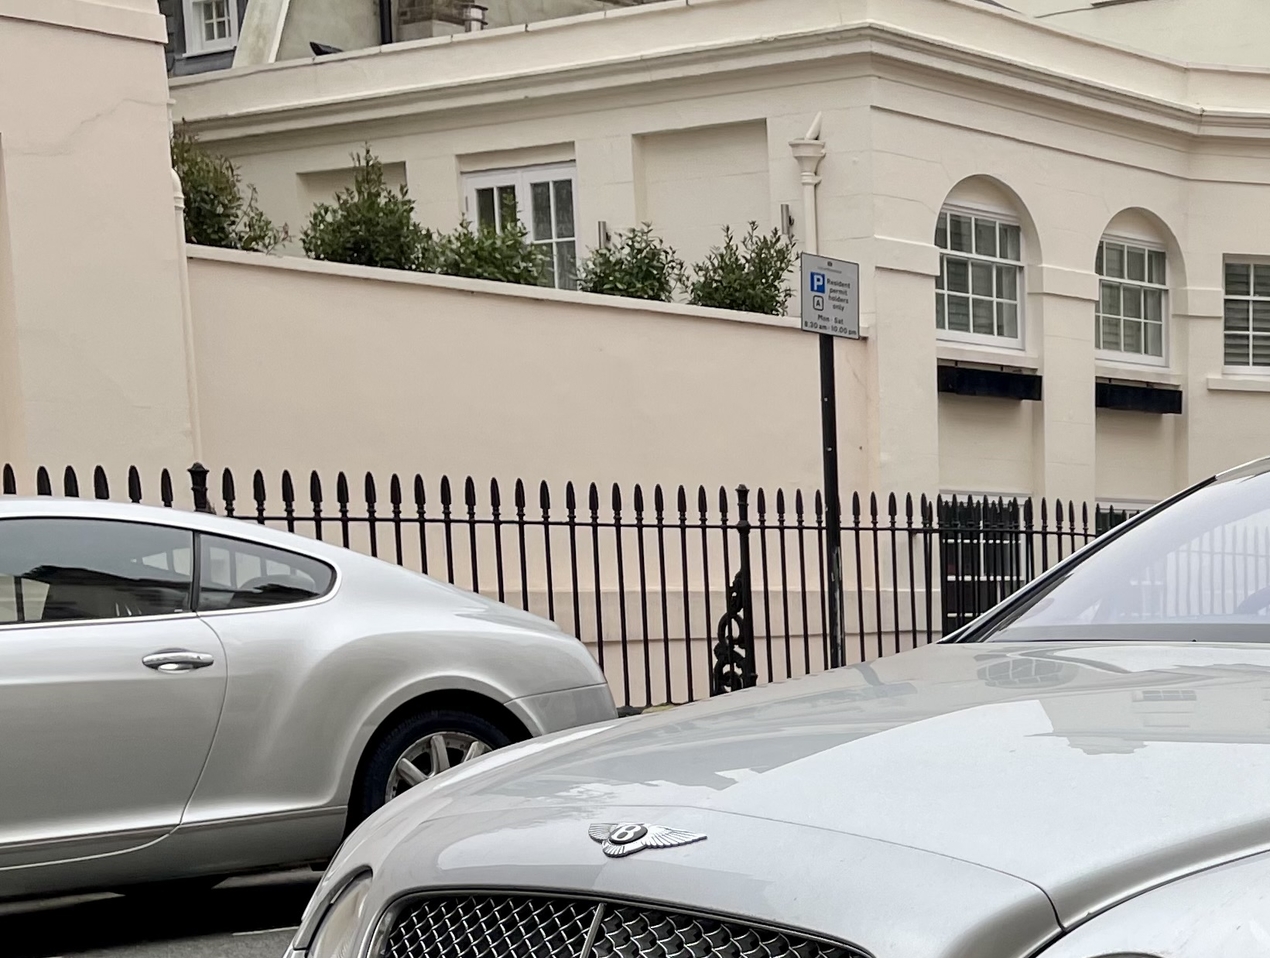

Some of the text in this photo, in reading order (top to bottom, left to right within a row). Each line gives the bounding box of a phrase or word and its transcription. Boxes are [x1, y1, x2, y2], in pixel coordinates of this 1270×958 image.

[813, 274, 824, 291] P
[827, 278, 851, 289] Resident
[829, 288, 848, 296] permit
[828, 295, 849, 304] holders
[833, 304, 845, 312] only
[818, 314, 844, 325] Mon Sat
[611, 824, 641, 841] B
